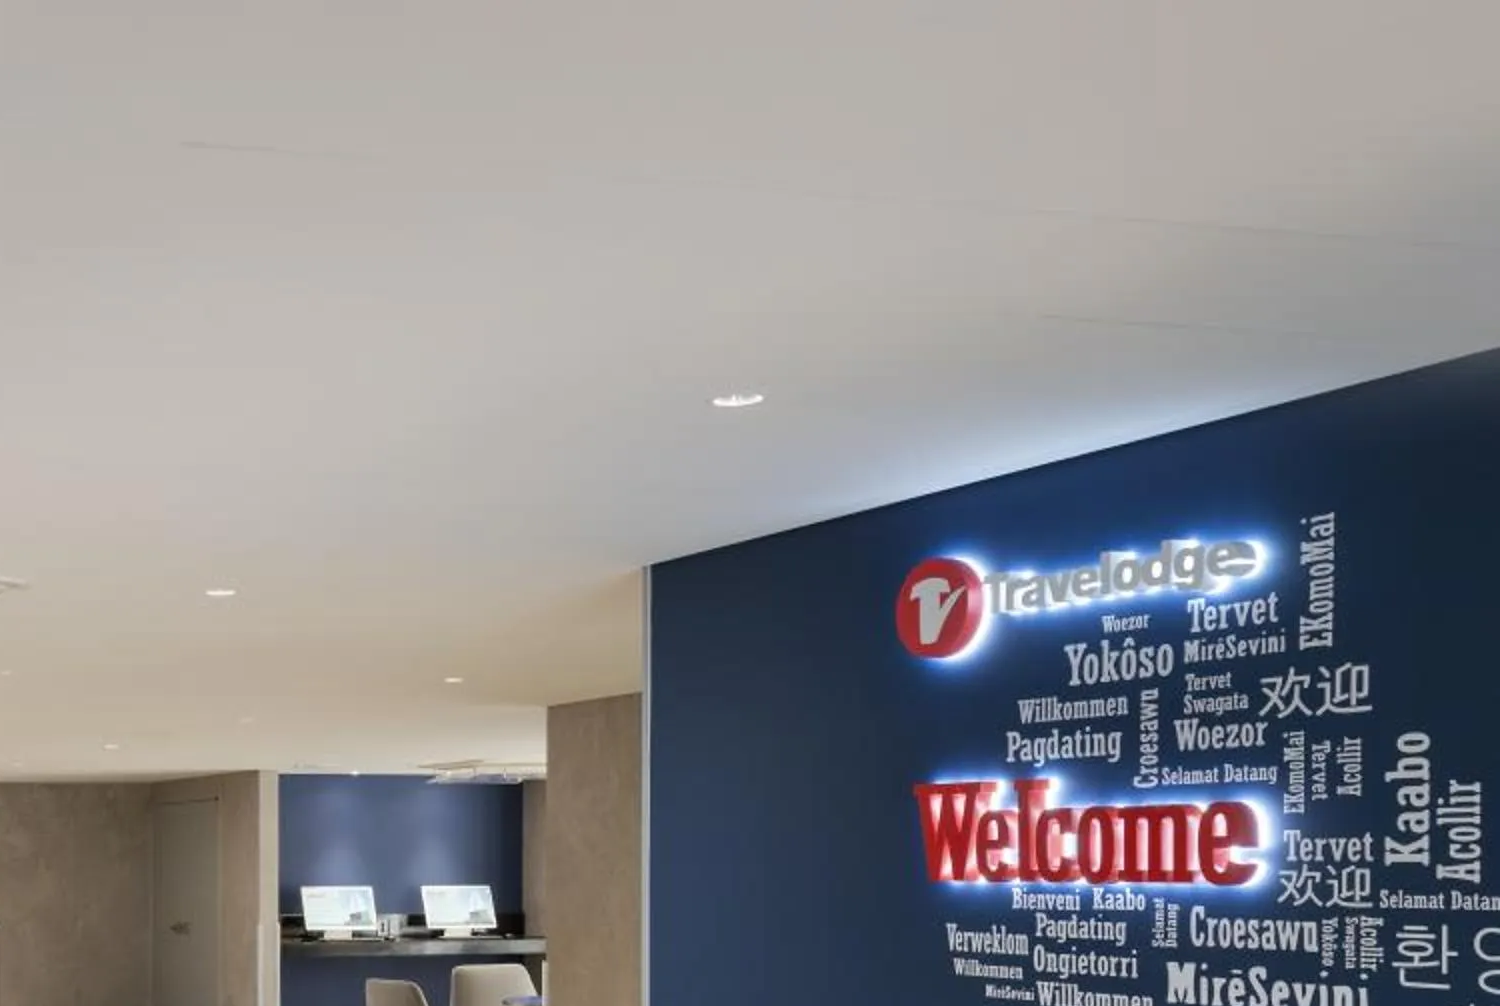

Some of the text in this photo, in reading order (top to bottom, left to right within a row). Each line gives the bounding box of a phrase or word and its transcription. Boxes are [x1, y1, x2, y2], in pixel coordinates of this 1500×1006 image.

[984, 538, 1260, 613] Travelodge
[1300, 512, 1335, 650] EKomoMai
[1102, 615, 1150, 634] Woezor
[1187, 592, 1279, 633] Tervet
[1064, 637, 1174, 686] Yokôso
[1184, 672, 1232, 691] Tervet
[1259, 662, 1372, 718] 欢迎
[1017, 695, 1129, 724] Willkommen
[1183, 692, 1249, 716] Swagata
[1006, 727, 1122, 767] Pagdating
[1174, 718, 1268, 752] Woezor
[1161, 763, 1278, 785] Selamat Datang
[1311, 740, 1331, 800] Tervet
[1336, 736, 1361, 796] Acollir
[1384, 731, 1431, 866] Kaabo
[913, 779, 1262, 886] Welcome
[1284, 829, 1374, 862] Tervet
[1437, 779, 1481, 884] Acollir
[1012, 886, 1146, 911] Bienveni Kaabo
[1277, 864, 1373, 908] 欢迎
[1379, 889, 1444, 909] Selamat
[946, 923, 1029, 956] Verweklom
[1036, 912, 1127, 946] Pagdating
[953, 957, 1023, 980] Willkommen
[1033, 945, 1139, 979] Ongietorri
